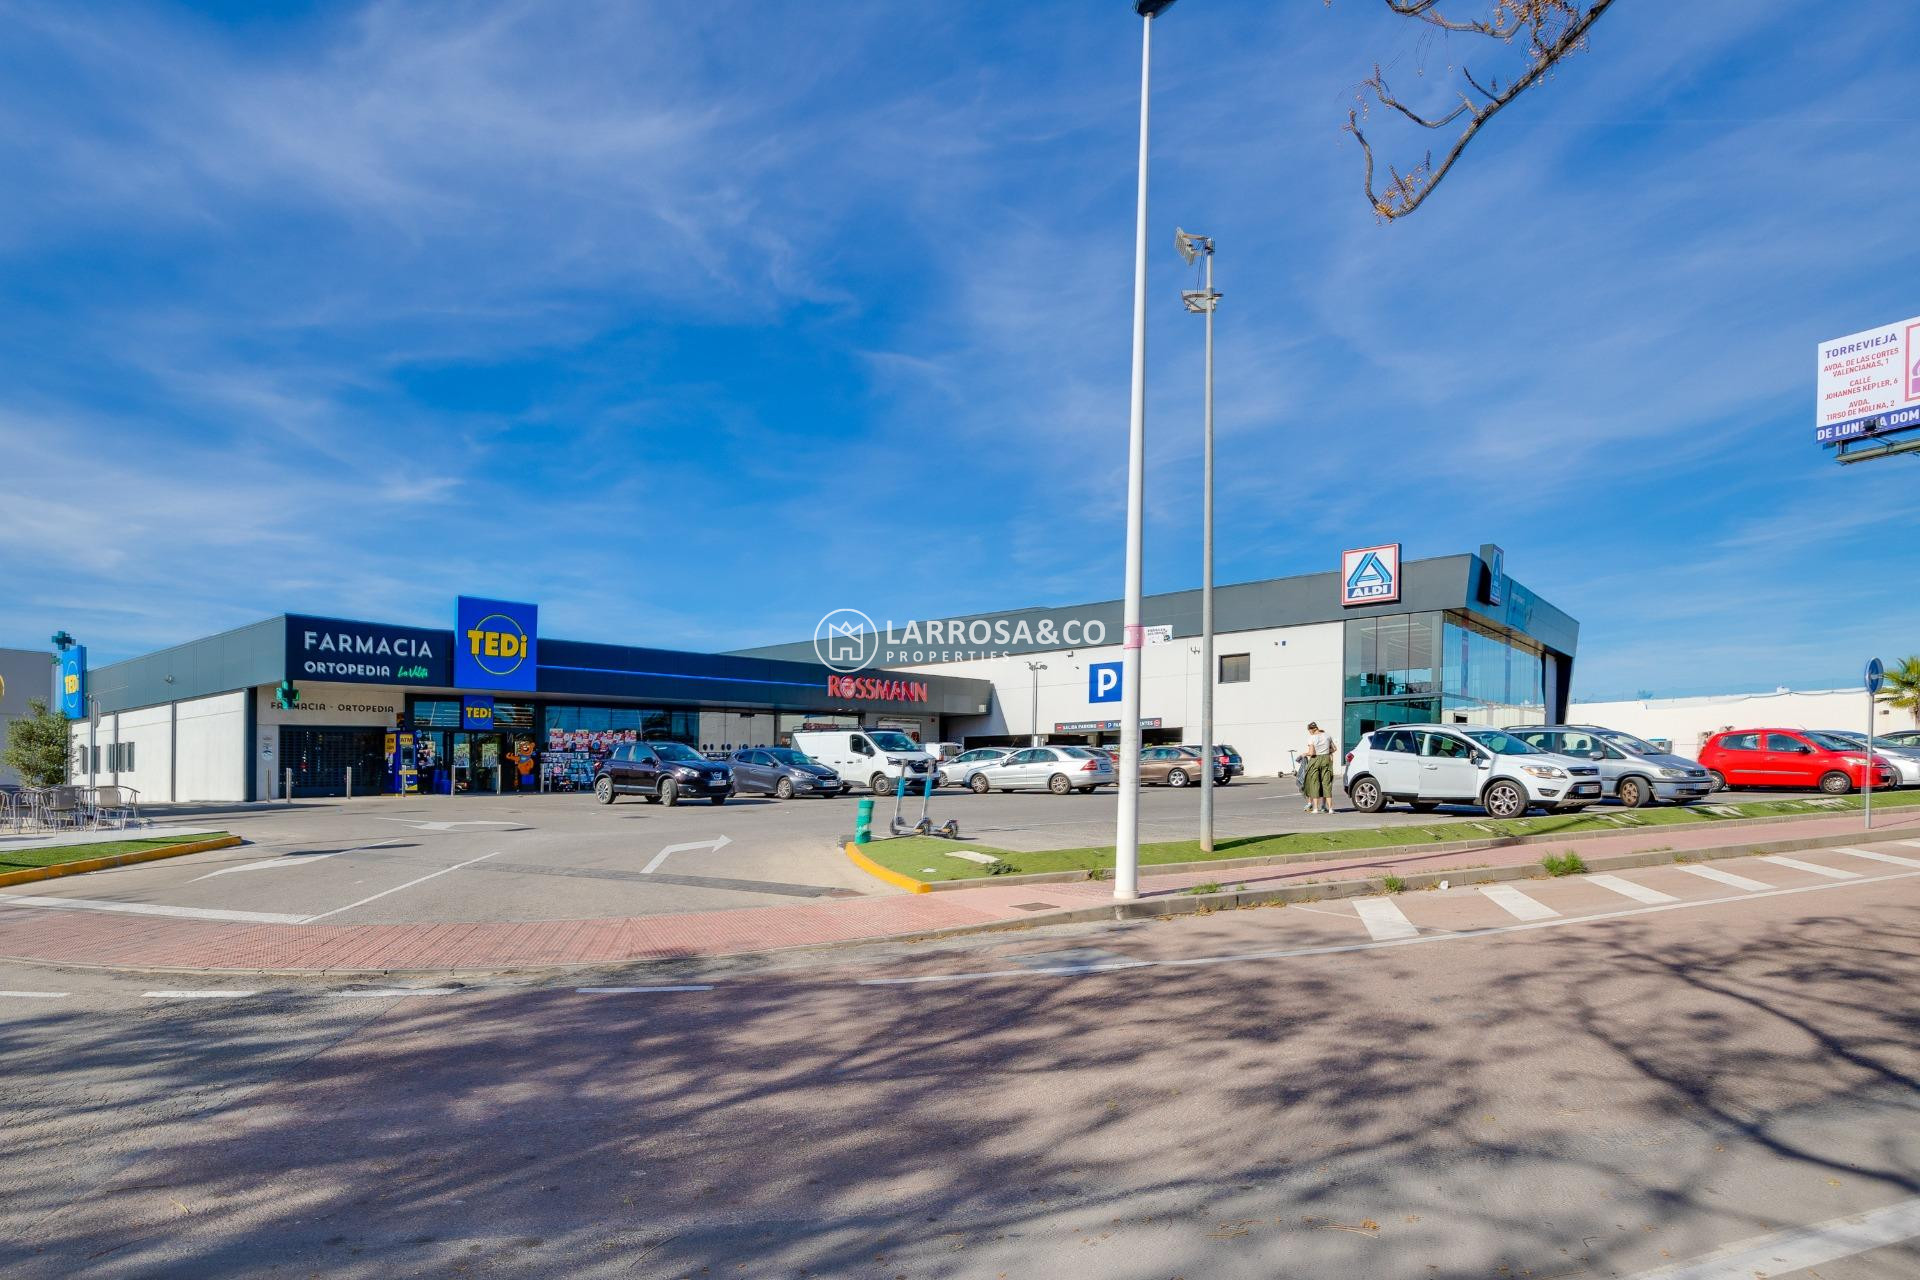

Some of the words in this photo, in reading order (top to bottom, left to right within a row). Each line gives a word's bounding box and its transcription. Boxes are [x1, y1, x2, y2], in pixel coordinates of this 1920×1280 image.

[1825, 333, 1897, 358] TORREVIEJA
[1824, 362, 1844, 372] AVDA.
[1846, 359, 1855, 367] DE
[1856, 354, 1870, 364] LAS
[1872, 347, 1899, 360] CORTES
[1832, 359, 1883, 377] VALENCIANAS,
[1825, 386, 1861, 400] JOHANNES
[1862, 379, 1892, 392] KEPLER,
[1849, 376, 1871, 387] CALLE
[1826, 411, 1846, 421] TIRSO
[1847, 409, 1857, 417] DE
[1858, 402, 1889, 414] MOLINA,
[1848, 398, 1869, 408] AVDA.
[1817, 428, 1833, 440] DE
[1835, 420, 1866, 437] LUNE
[1880, 416, 1888, 427] A
[1351, 585, 1388, 597] ALDI
[304, 630, 433, 658] FARMACIA
[467, 629, 528, 658] TEDi
[304, 661, 390, 677] ORTOPEDIA
[828, 675, 928, 703] ROSSMANN
[1097, 668, 1118, 697] P
[270, 702, 326, 711] FAMACIA
[337, 703, 394, 713] ORTOPEDIA
[466, 706, 492, 718] TEDi
